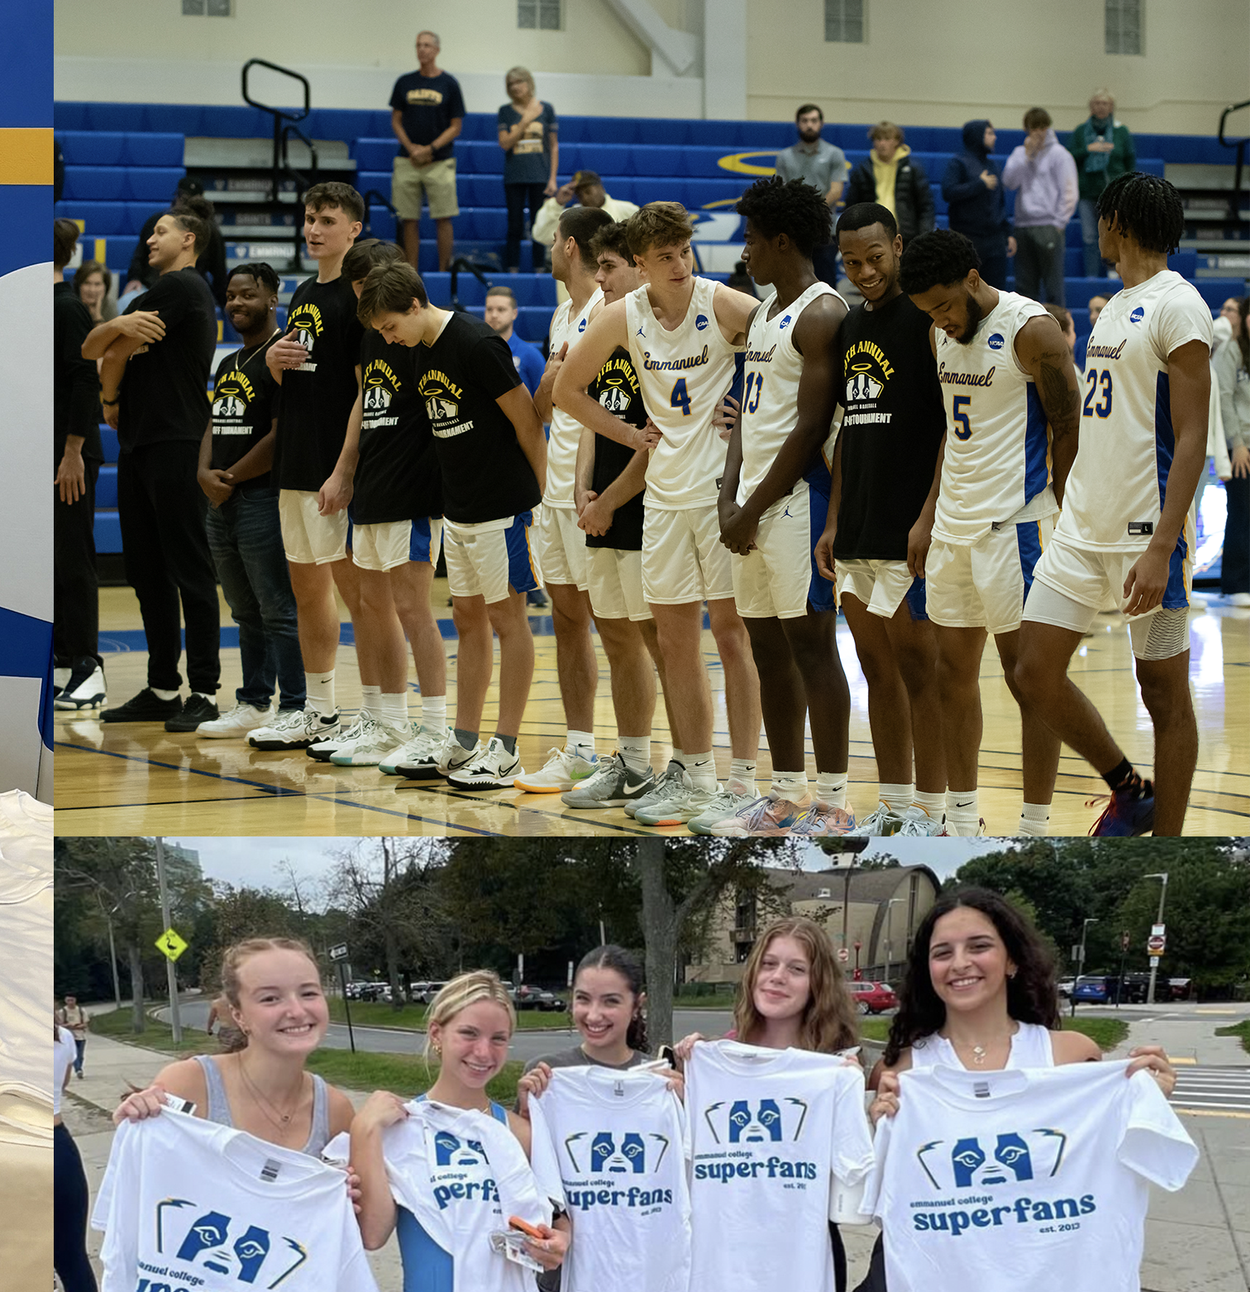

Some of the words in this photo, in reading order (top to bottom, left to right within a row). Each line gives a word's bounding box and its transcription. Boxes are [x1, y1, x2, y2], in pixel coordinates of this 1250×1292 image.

[857, 340, 895, 380] ANNUAL
[939, 361, 996, 387] Emmanuel
[670, 377, 692, 417] 4
[742, 371, 764, 414] 13
[1083, 367, 1113, 419] 23
[953, 394, 973, 441] 5
[695, 1156, 817, 1184] superfans
[566, 1187, 672, 1211] uperfans
[910, 1198, 956, 1209] emmanuel
[958, 1195, 994, 1206] college
[913, 1194, 1097, 1237] superfans
[169, 1269, 206, 1287] college
